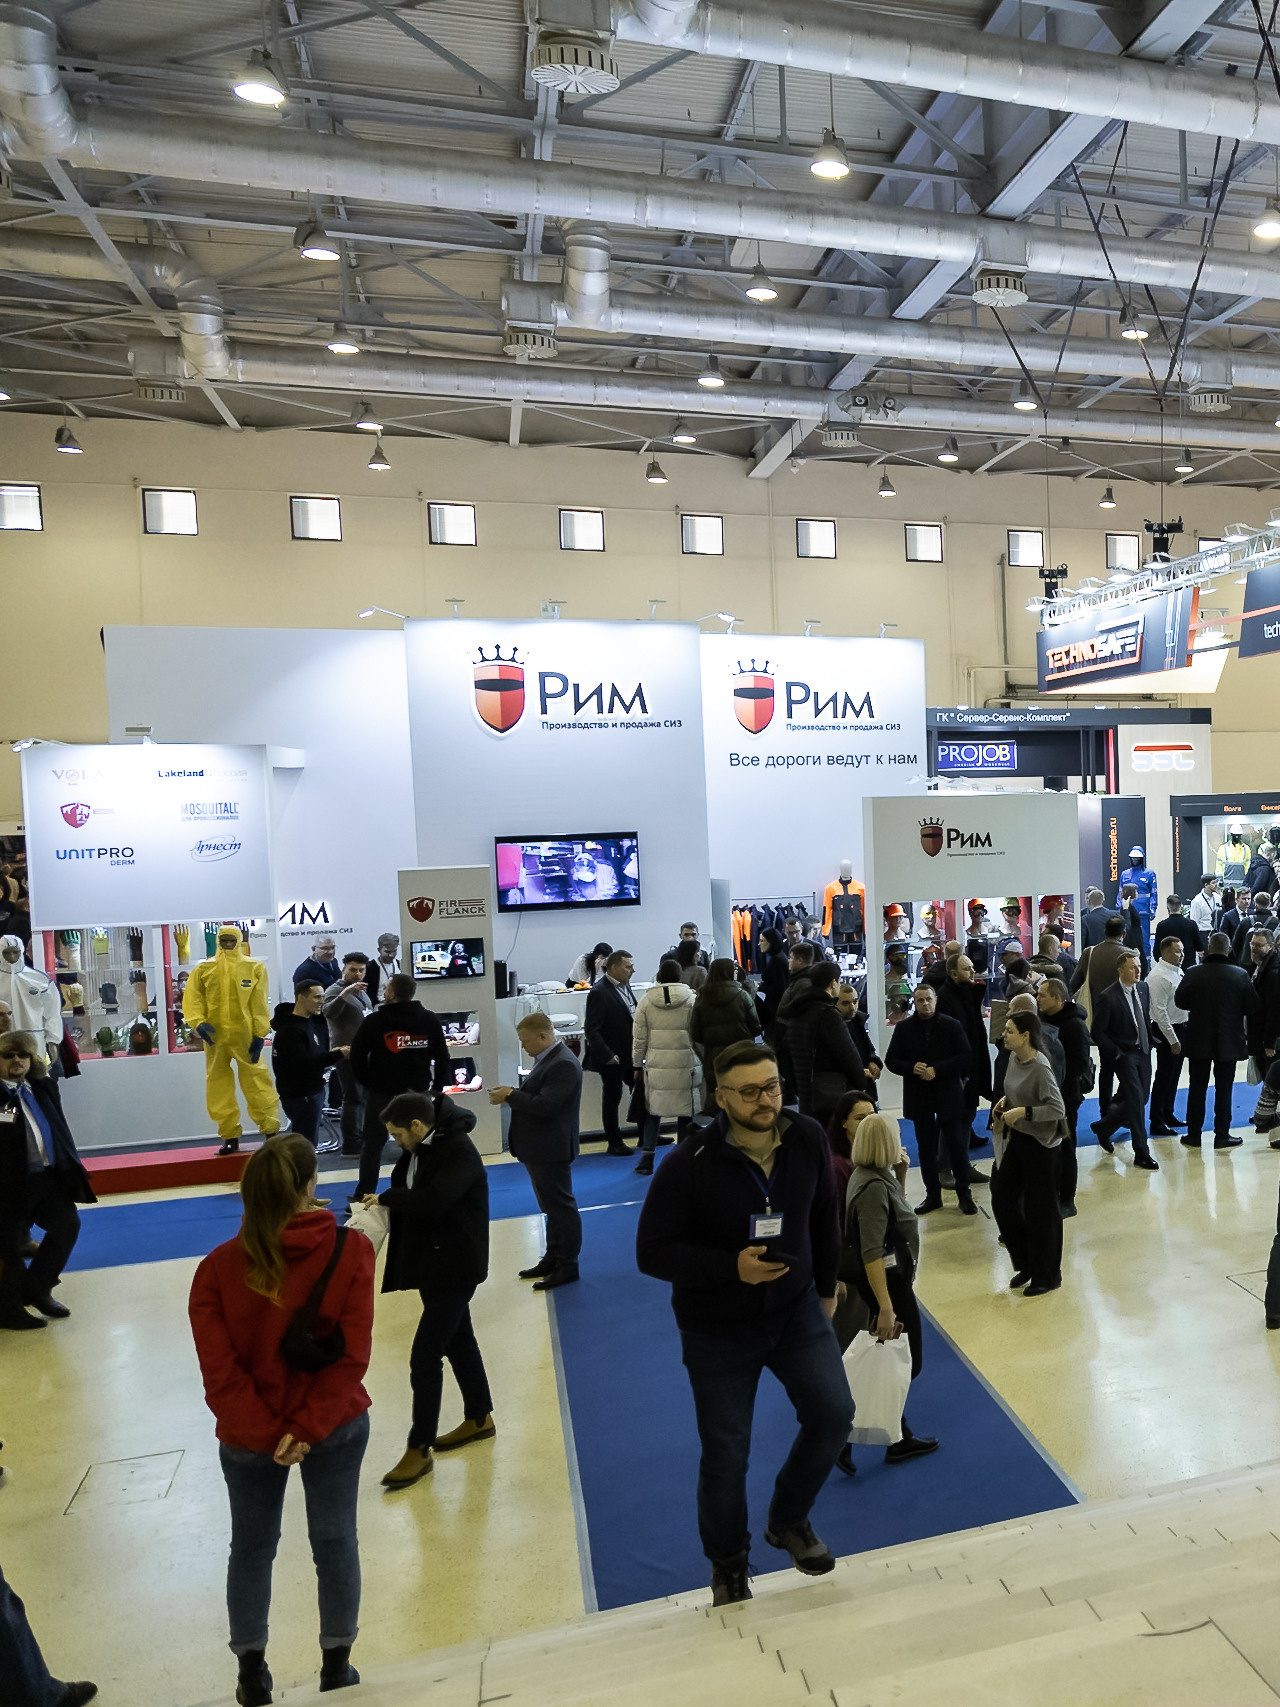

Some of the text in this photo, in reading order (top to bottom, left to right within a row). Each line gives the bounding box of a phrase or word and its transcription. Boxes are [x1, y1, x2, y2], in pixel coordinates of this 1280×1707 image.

[1046, 628, 1137, 668] TECHNOSAFE
[936, 713, 949, 722] ГК
[541, 721, 609, 730] Производство
[620, 721, 661, 730] продажа
[664, 719, 682, 728] СИЗ
[786, 723, 841, 731] Производство
[849, 723, 883, 731] продажа
[730, 752, 918, 769] Все дороги ведут к нам
[938, 744, 1011, 766] PROJOB
[158, 769, 204, 777] Lakeland
[56, 847, 134, 860] UNITPRO
[1109, 817, 1117, 881] technosafe.ru
[439, 906, 486, 916] FLANCK
